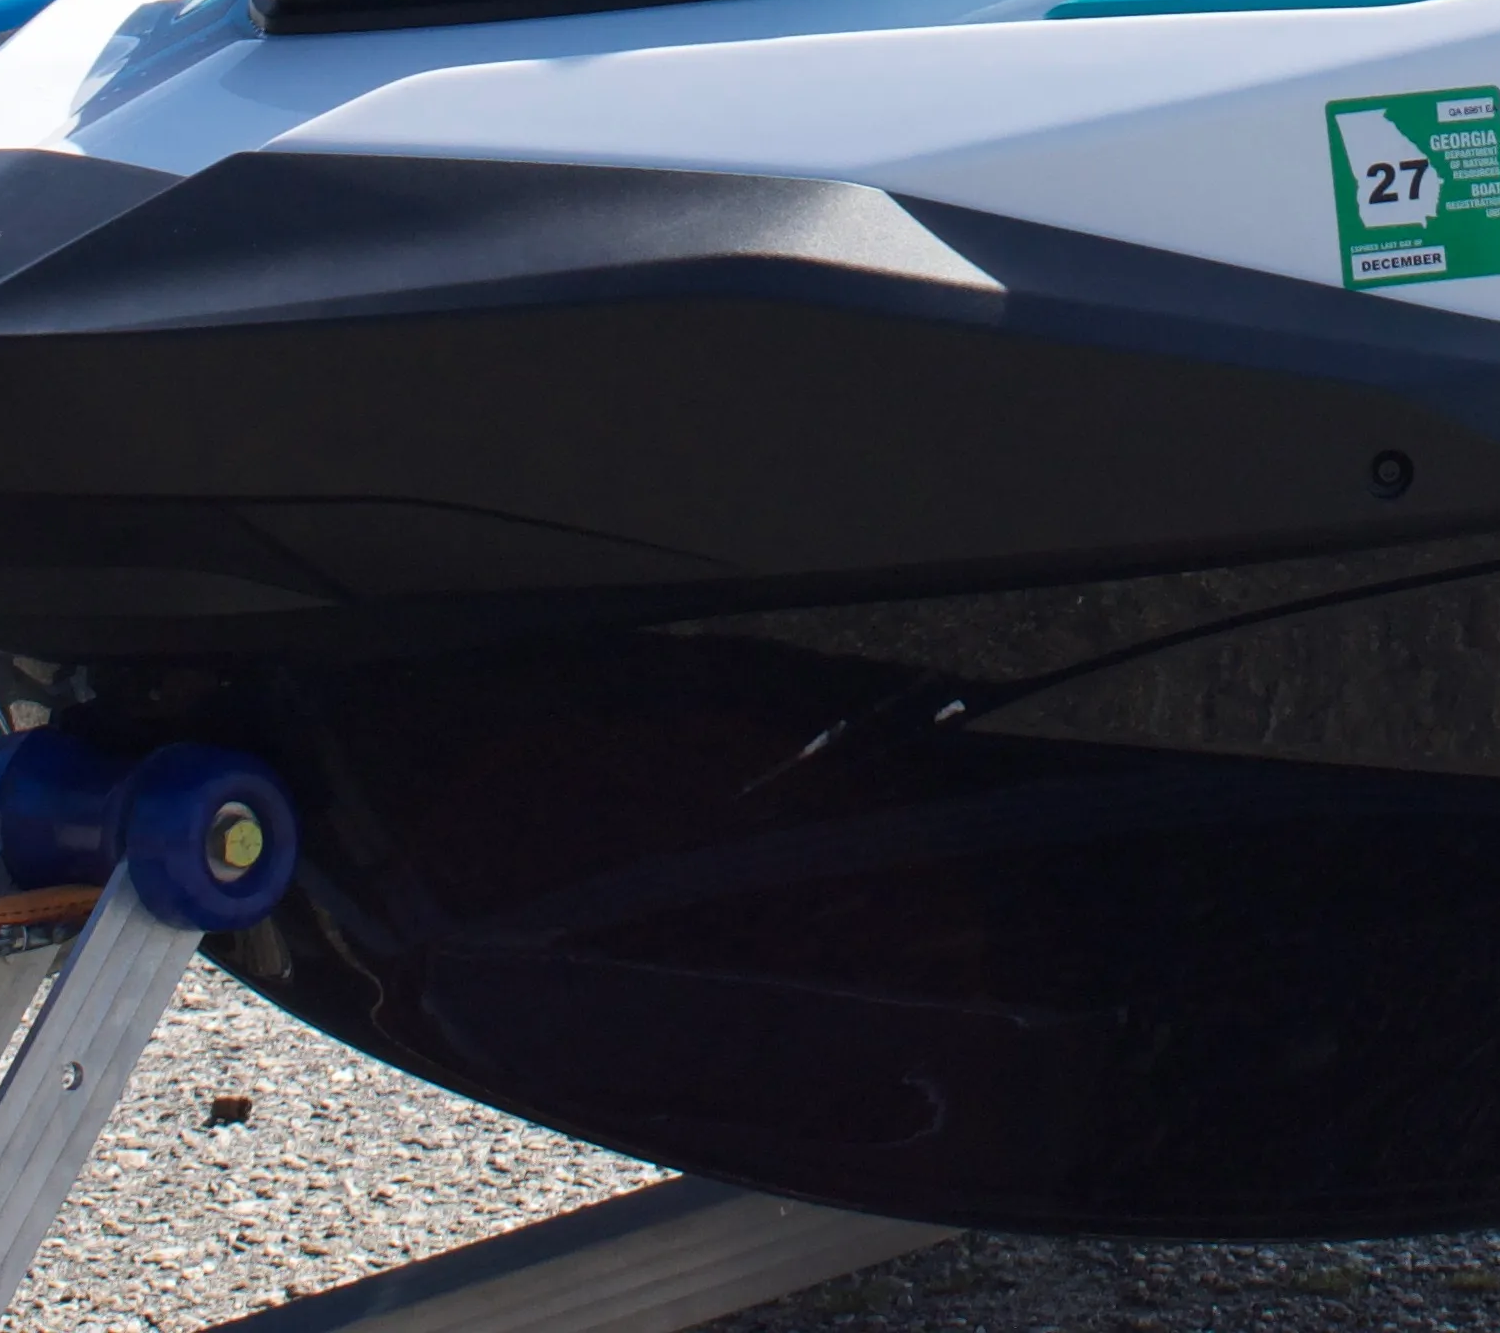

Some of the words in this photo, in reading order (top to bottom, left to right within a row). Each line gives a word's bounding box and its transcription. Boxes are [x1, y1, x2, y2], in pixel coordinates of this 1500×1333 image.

[1430, 130, 1497, 151] GEORGIA
[1444, 146, 1498, 160] DEPARTMENT
[1367, 160, 1429, 205] 27
[1361, 252, 1443, 273] DECEMBER
